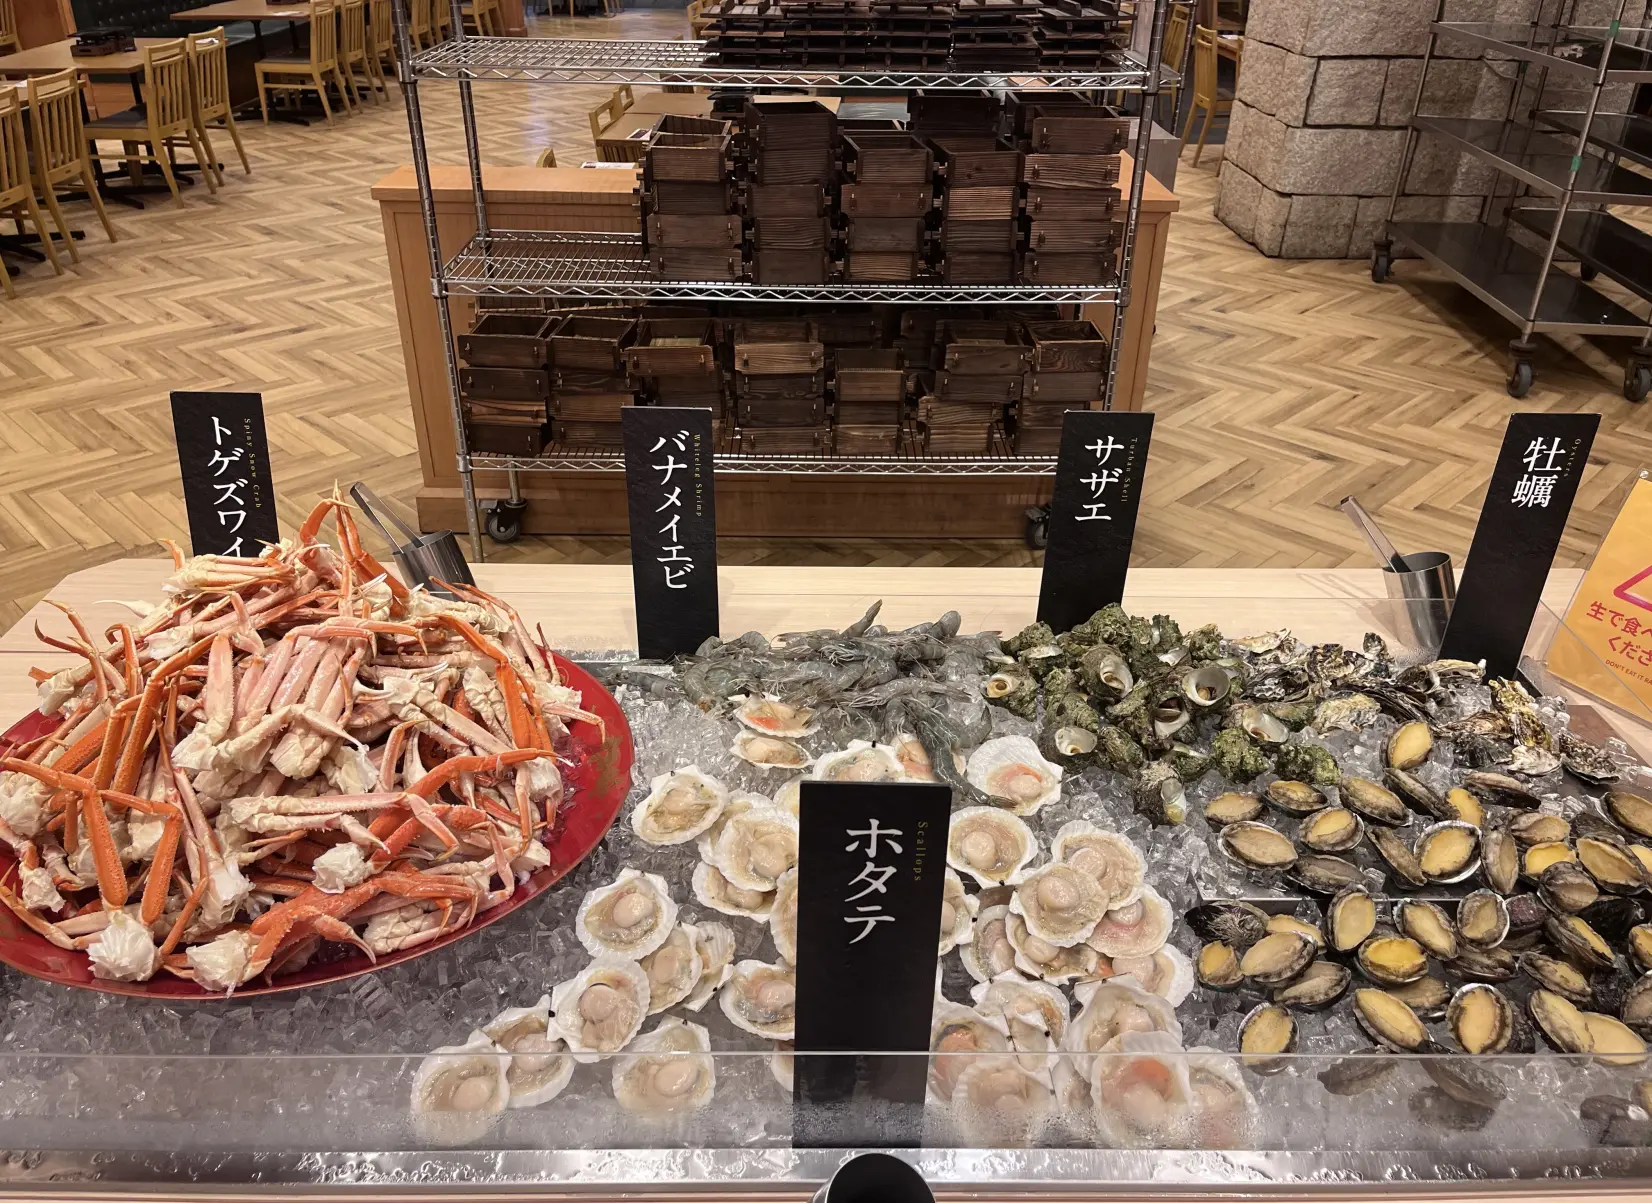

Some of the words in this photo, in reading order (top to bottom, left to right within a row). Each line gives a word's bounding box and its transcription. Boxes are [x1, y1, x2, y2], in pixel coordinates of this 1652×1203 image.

[244, 418, 252, 446] Spiny
[248, 453, 257, 478] Snow
[693, 434, 701, 478] Whiteleg
[1126, 438, 1138, 472] Turban
[1564, 438, 1581, 477] Oysters
[207, 416, 248, 558] トゲズワイ
[252, 484, 261, 508] Crab
[1074, 435, 1125, 521] サザエ
[1121, 478, 1131, 502] Shell
[649, 430, 695, 589] バナメイエビ
[1605, 659, 1625, 671] DON'T
[1625, 668, 1637, 677] EAT
[913, 821, 928, 881] Scallops
[844, 818, 903, 944] ホタテ
